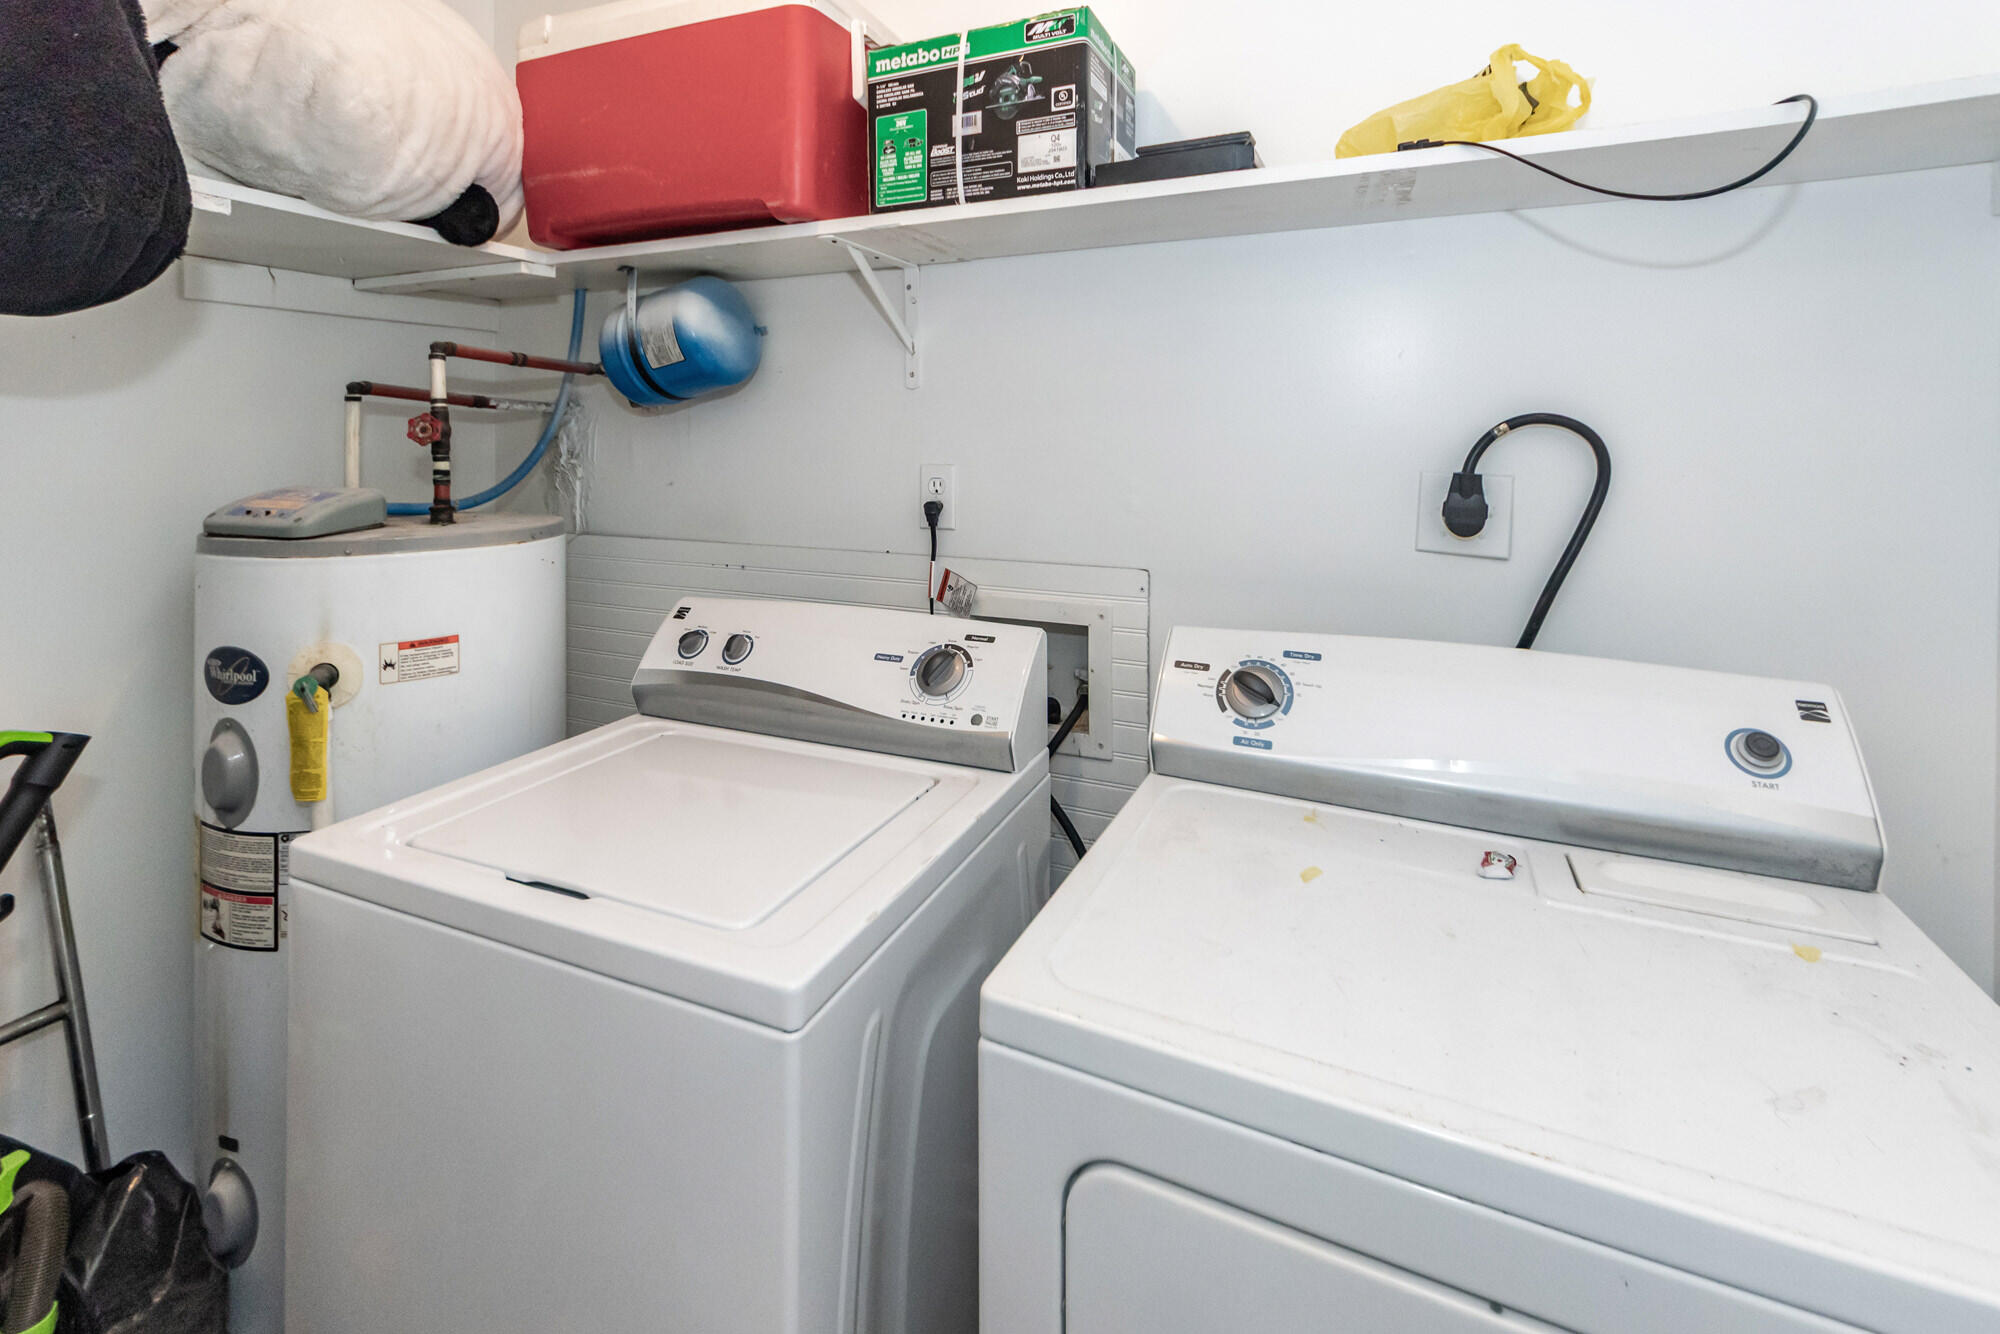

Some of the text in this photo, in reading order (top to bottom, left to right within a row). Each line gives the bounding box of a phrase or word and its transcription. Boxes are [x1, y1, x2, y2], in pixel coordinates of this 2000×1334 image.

[876, 48, 940, 73] metabo
[1030, 173, 1054, 182] Holdings
[209, 664, 257, 686] Whirlpool
[1751, 780, 1780, 791] START
